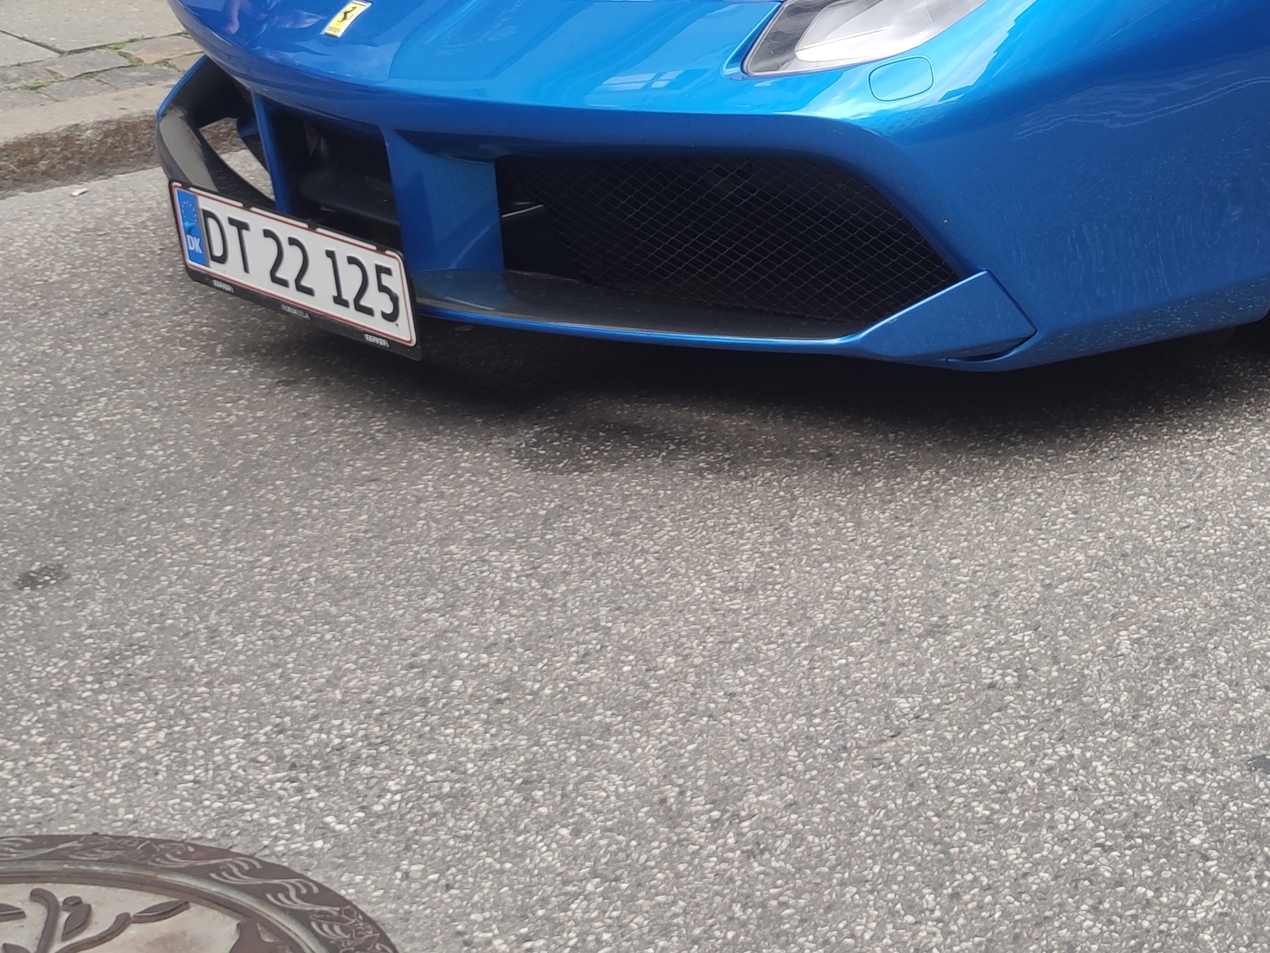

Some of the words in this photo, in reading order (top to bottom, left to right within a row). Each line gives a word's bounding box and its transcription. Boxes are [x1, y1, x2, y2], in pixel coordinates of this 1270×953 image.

[187, 235, 203, 255] DK
[202, 208, 251, 274] DT
[263, 229, 316, 297] 22
[325, 249, 401, 324] 125
